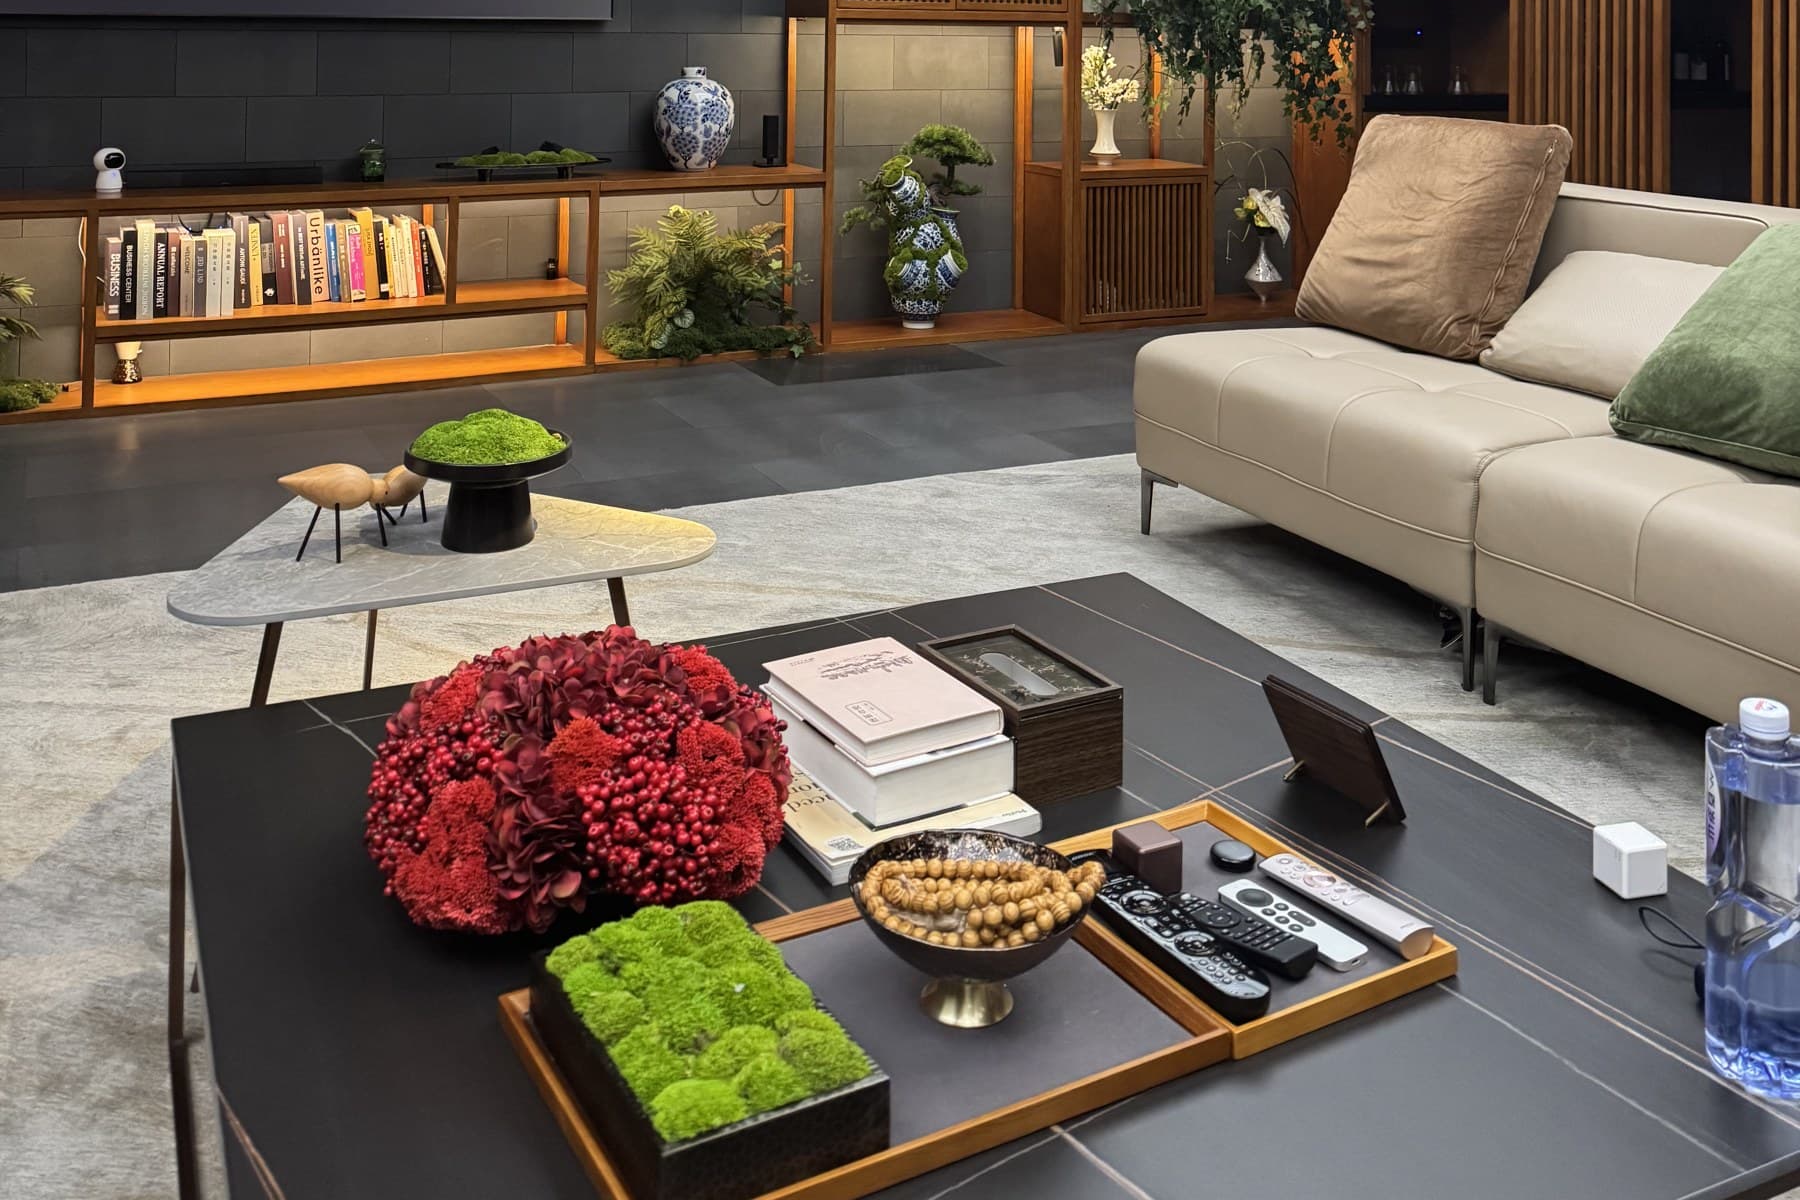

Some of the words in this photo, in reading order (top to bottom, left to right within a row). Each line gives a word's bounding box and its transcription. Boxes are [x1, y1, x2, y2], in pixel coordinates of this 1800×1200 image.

[126, 244, 134, 276] BUSINESS
[156, 242, 166, 275] ANNUAL
[310, 217, 323, 295] Urbänlike
[109, 253, 120, 297] BUSINESS
[155, 276, 165, 309] REPORT
